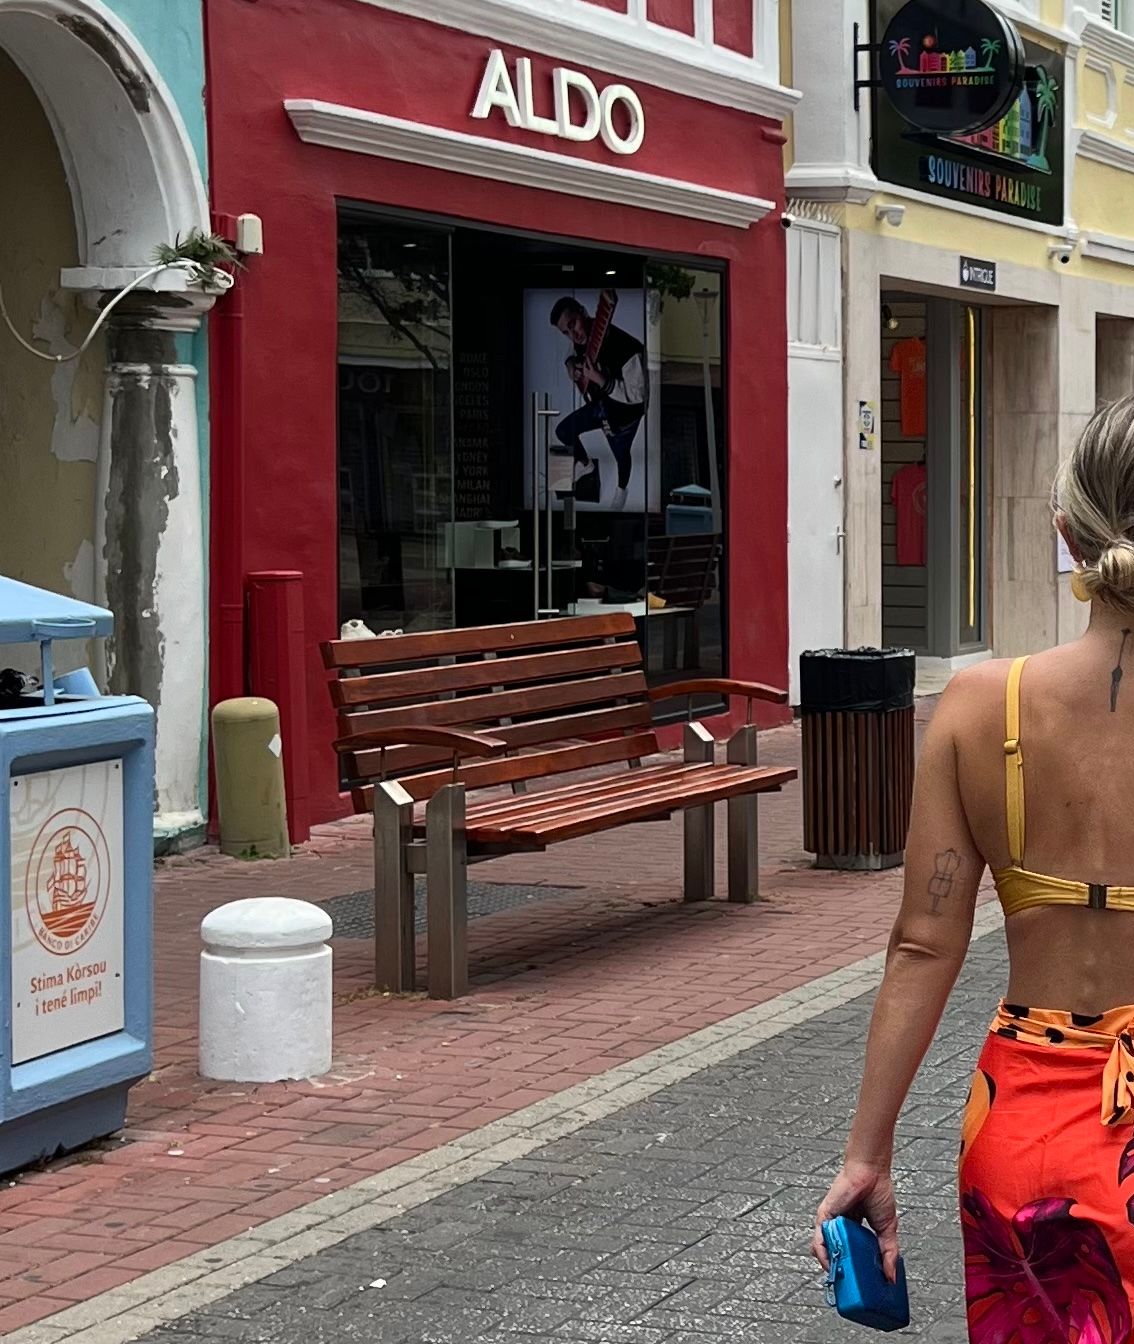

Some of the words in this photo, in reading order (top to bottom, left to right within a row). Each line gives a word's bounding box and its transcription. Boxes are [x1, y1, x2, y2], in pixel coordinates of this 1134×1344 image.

[896, 76, 947, 89] SOUVENIRS
[951, 74, 994, 86] PARADISE
[469, 48, 645, 155] ALDO
[928, 155, 991, 198] SOUVENIRS
[995, 174, 1041, 212] PARADISE
[38, 927, 63, 950] BANCO
[65, 940, 73, 951] DI
[75, 913, 99, 946] CARIBE
[30, 972, 64, 994] Stima
[66, 960, 107, 984] Kòrsou
[35, 999, 40, 1017] i
[41, 989, 67, 1015] tené
[70, 981, 103, 1007] limpi!
